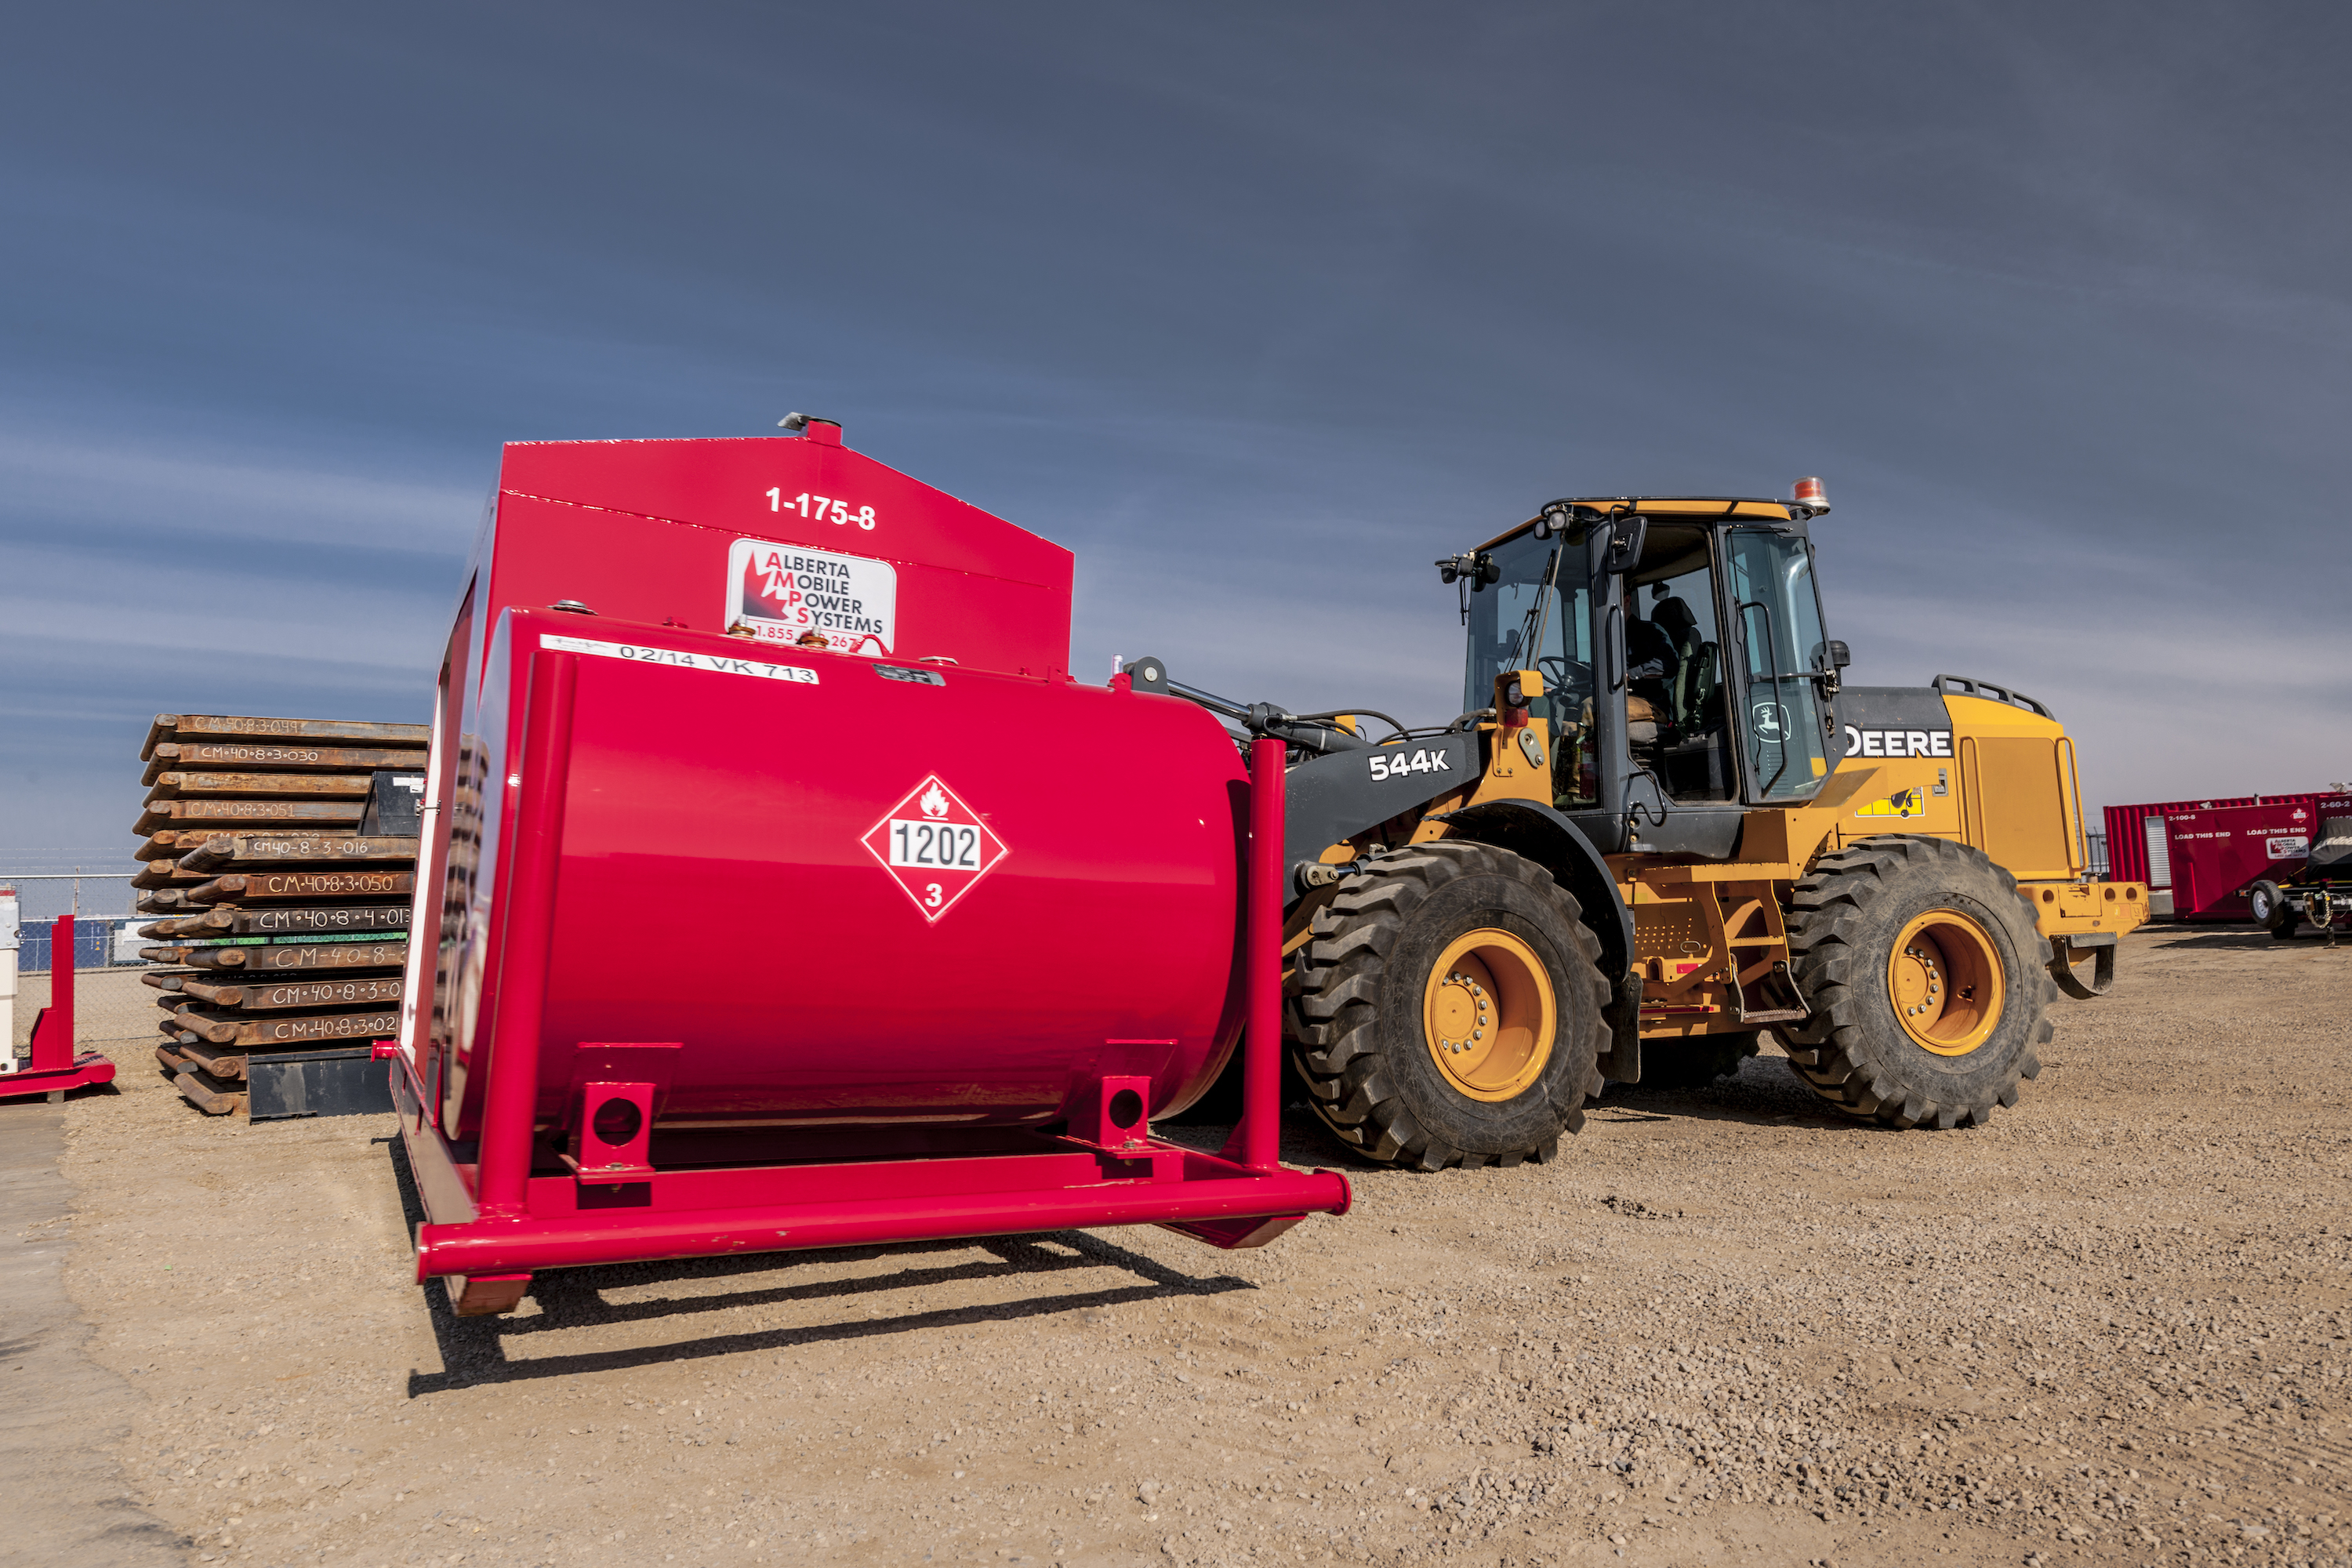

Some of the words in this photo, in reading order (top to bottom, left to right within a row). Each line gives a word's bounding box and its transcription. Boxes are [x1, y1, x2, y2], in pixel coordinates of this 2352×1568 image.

[765, 486, 877, 531] 1-175-8
[765, 552, 851, 579] ALBERTA
[774, 570, 850, 596] MOBILE
[788, 590, 862, 615] POWER
[797, 607, 884, 634] SYSTEMS
[619, 645, 696, 667] 02/14
[708, 656, 756, 675] VK
[762, 664, 815, 684] 713
[1844, 724, 1952, 757] DEERE
[1368, 749, 1450, 782] 544K
[895, 823, 976, 866] 1202
[924, 883, 944, 908] 3
